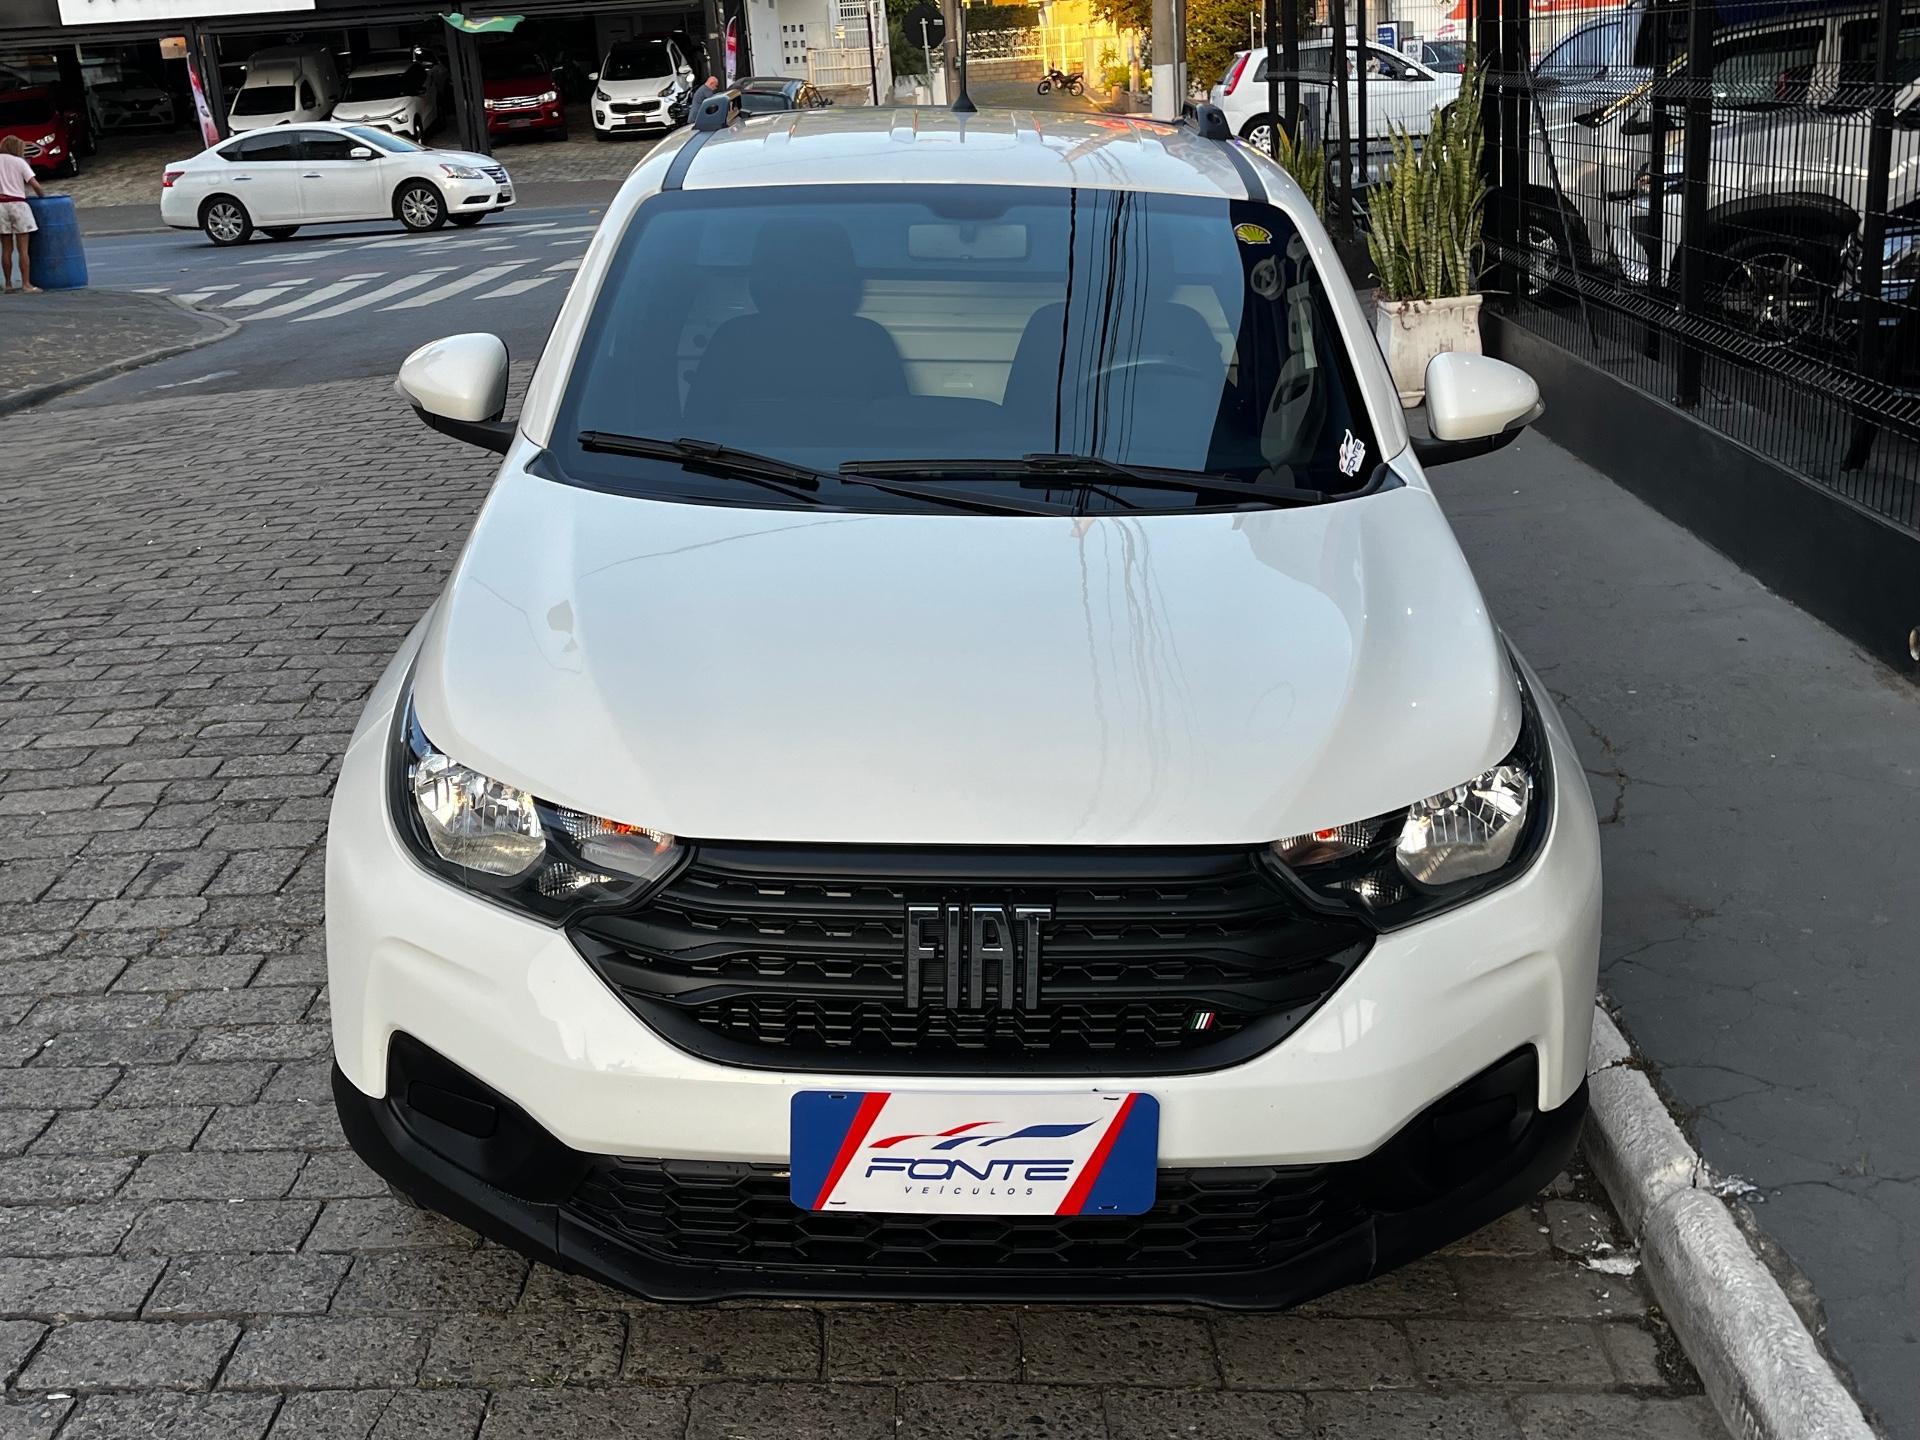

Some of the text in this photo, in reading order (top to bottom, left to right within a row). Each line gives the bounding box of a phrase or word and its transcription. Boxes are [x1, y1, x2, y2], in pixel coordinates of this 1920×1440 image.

[1345, 440, 1362, 475] FONTE
[906, 903, 1053, 1009] FIAT
[865, 1157, 1075, 1181] FONTE
[904, 1184, 1035, 1196] VEÍCULOS
